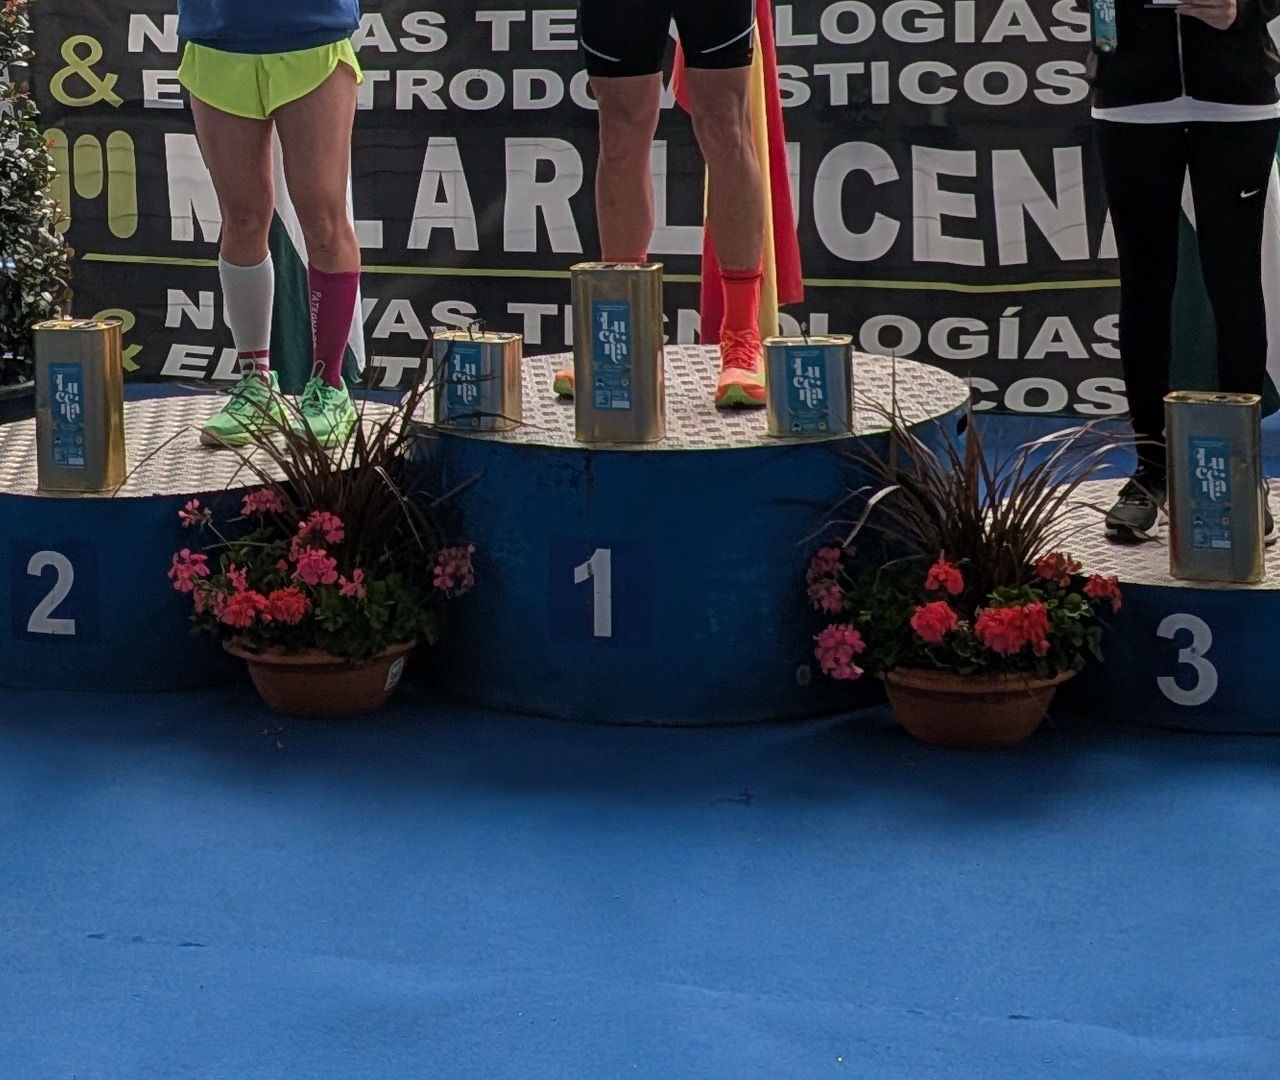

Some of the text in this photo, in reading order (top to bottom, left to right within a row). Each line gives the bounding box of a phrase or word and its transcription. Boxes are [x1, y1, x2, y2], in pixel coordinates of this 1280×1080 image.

[50, 35, 124, 108] &
[26, 551, 76, 636] 2
[574, 548, 612, 638] 1
[1156, 612, 1219, 707] 3
